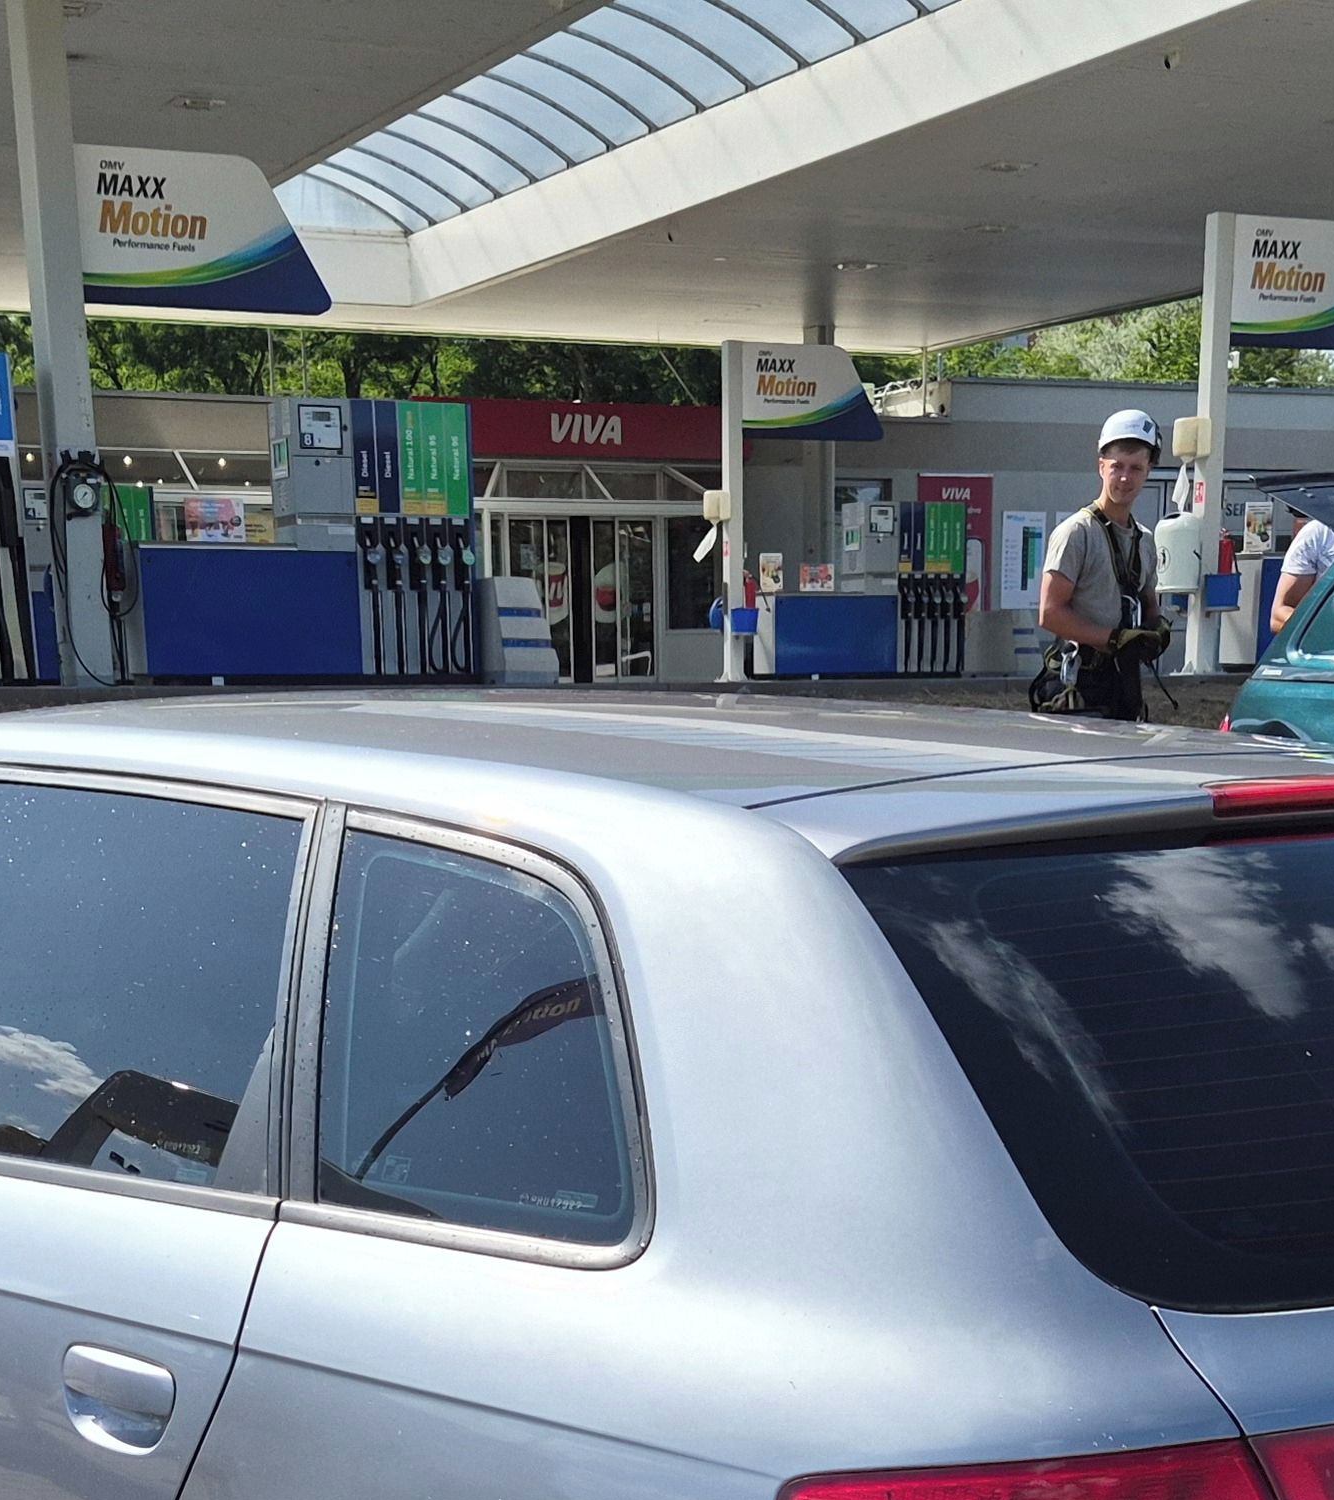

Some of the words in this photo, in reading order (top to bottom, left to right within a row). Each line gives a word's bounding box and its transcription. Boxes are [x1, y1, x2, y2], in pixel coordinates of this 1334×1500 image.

[99, 159, 126, 171] OMV
[96, 172, 167, 200] MAXX
[99, 199, 208, 240] Motion
[112, 238, 170, 251] Performance
[172, 241, 196, 253] Fuels
[1255, 228, 1275, 238] OMV
[1251, 238, 1302, 260] MAXX
[1250, 261, 1327, 293] Motion
[1258, 293, 1299, 303] Performance
[755, 358, 796, 373] MAXX
[756, 374, 817, 397] Motion
[303, 434, 313, 446] 8
[550, 412, 622, 445] VIVA
[360, 449, 369, 478] Diesel
[383, 450, 392, 478] Diesel
[405, 447, 415, 480] Natural
[429, 447, 439, 480] Natural
[452, 447, 460, 480] Natural
[941, 487, 971, 500] VIVA
